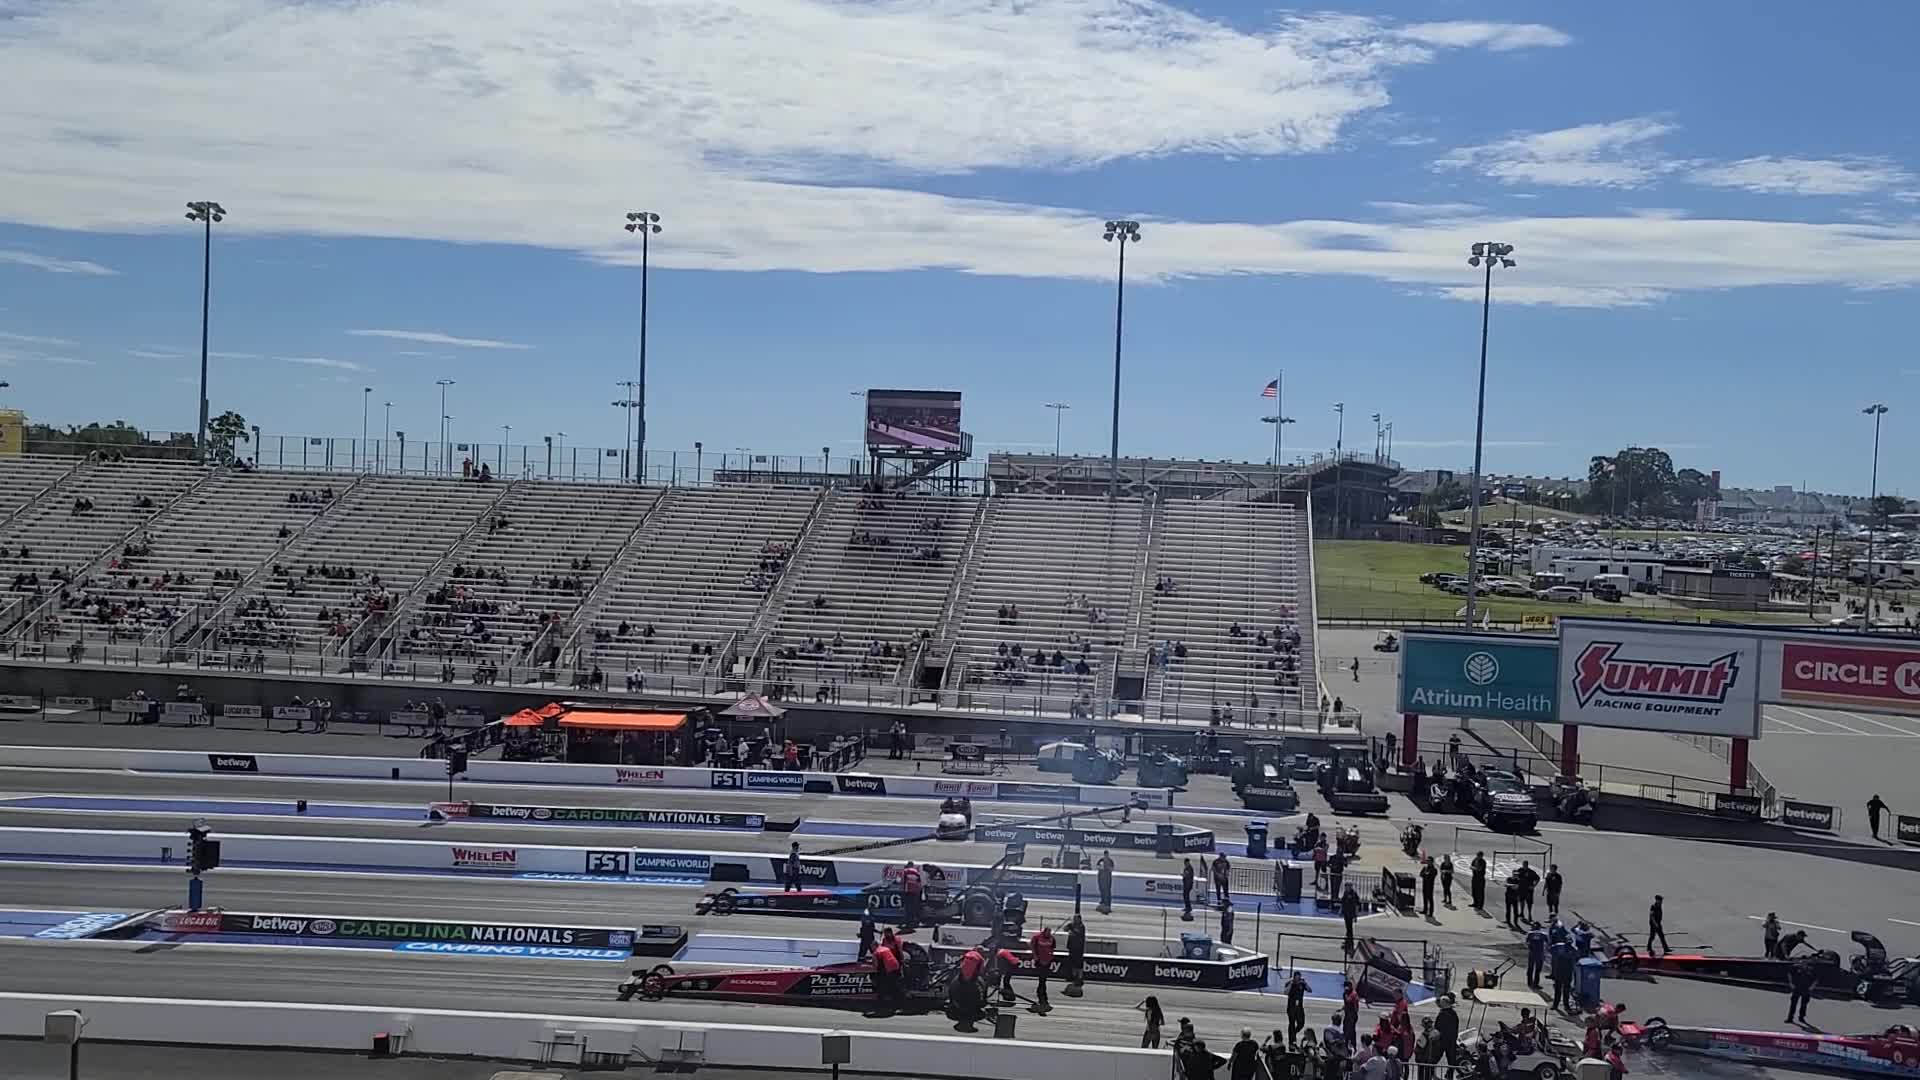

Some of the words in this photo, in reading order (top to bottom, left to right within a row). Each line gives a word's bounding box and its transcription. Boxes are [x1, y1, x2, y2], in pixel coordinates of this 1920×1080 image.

[1794, 660, 1888, 685] CIRCLE
[1411, 687, 1482, 708] Atrium
[1486, 691, 1552, 713] Health
[1593, 699, 1642, 711] RACING
[1645, 703, 1723, 716] EQUIPMENT
[217, 757, 251, 769] betway
[616, 768, 664, 780] WHELEN
[713, 772, 741, 786] FS1
[748, 775, 778, 784] CAMPING
[778, 777, 803, 785] WORLD
[845, 778, 878, 790] betway
[492, 806, 532, 819] betway
[1717, 799, 1759, 814] betway
[554, 809, 644, 821] CAROLINA
[648, 812, 721, 824] NATIONALS
[1786, 807, 1829, 823] betway
[1084, 834, 1116, 845] betway
[1134, 836, 1157, 845] betw
[1185, 834, 1211, 847] betway
[452, 848, 516, 862] WHELEN
[589, 853, 626, 871] FS1
[636, 857, 676, 867] CAMPING
[676, 859, 709, 869] WORLD
[179, 915, 205, 926] LUCAS
[205, 917, 218, 926] OIL
[253, 916, 307, 934] betway
[339, 920, 466, 939] CAROLINA
[471, 926, 574, 943] NATIONALS
[406, 941, 522, 954] CAMPING
[528, 946, 623, 958] WORLD
[1083, 960, 1128, 977] betway
[1154, 965, 1201, 982] betway
[1228, 962, 1265, 979] betway
[810, 974, 837, 987] Pep
[838, 973, 873, 987] Boys
